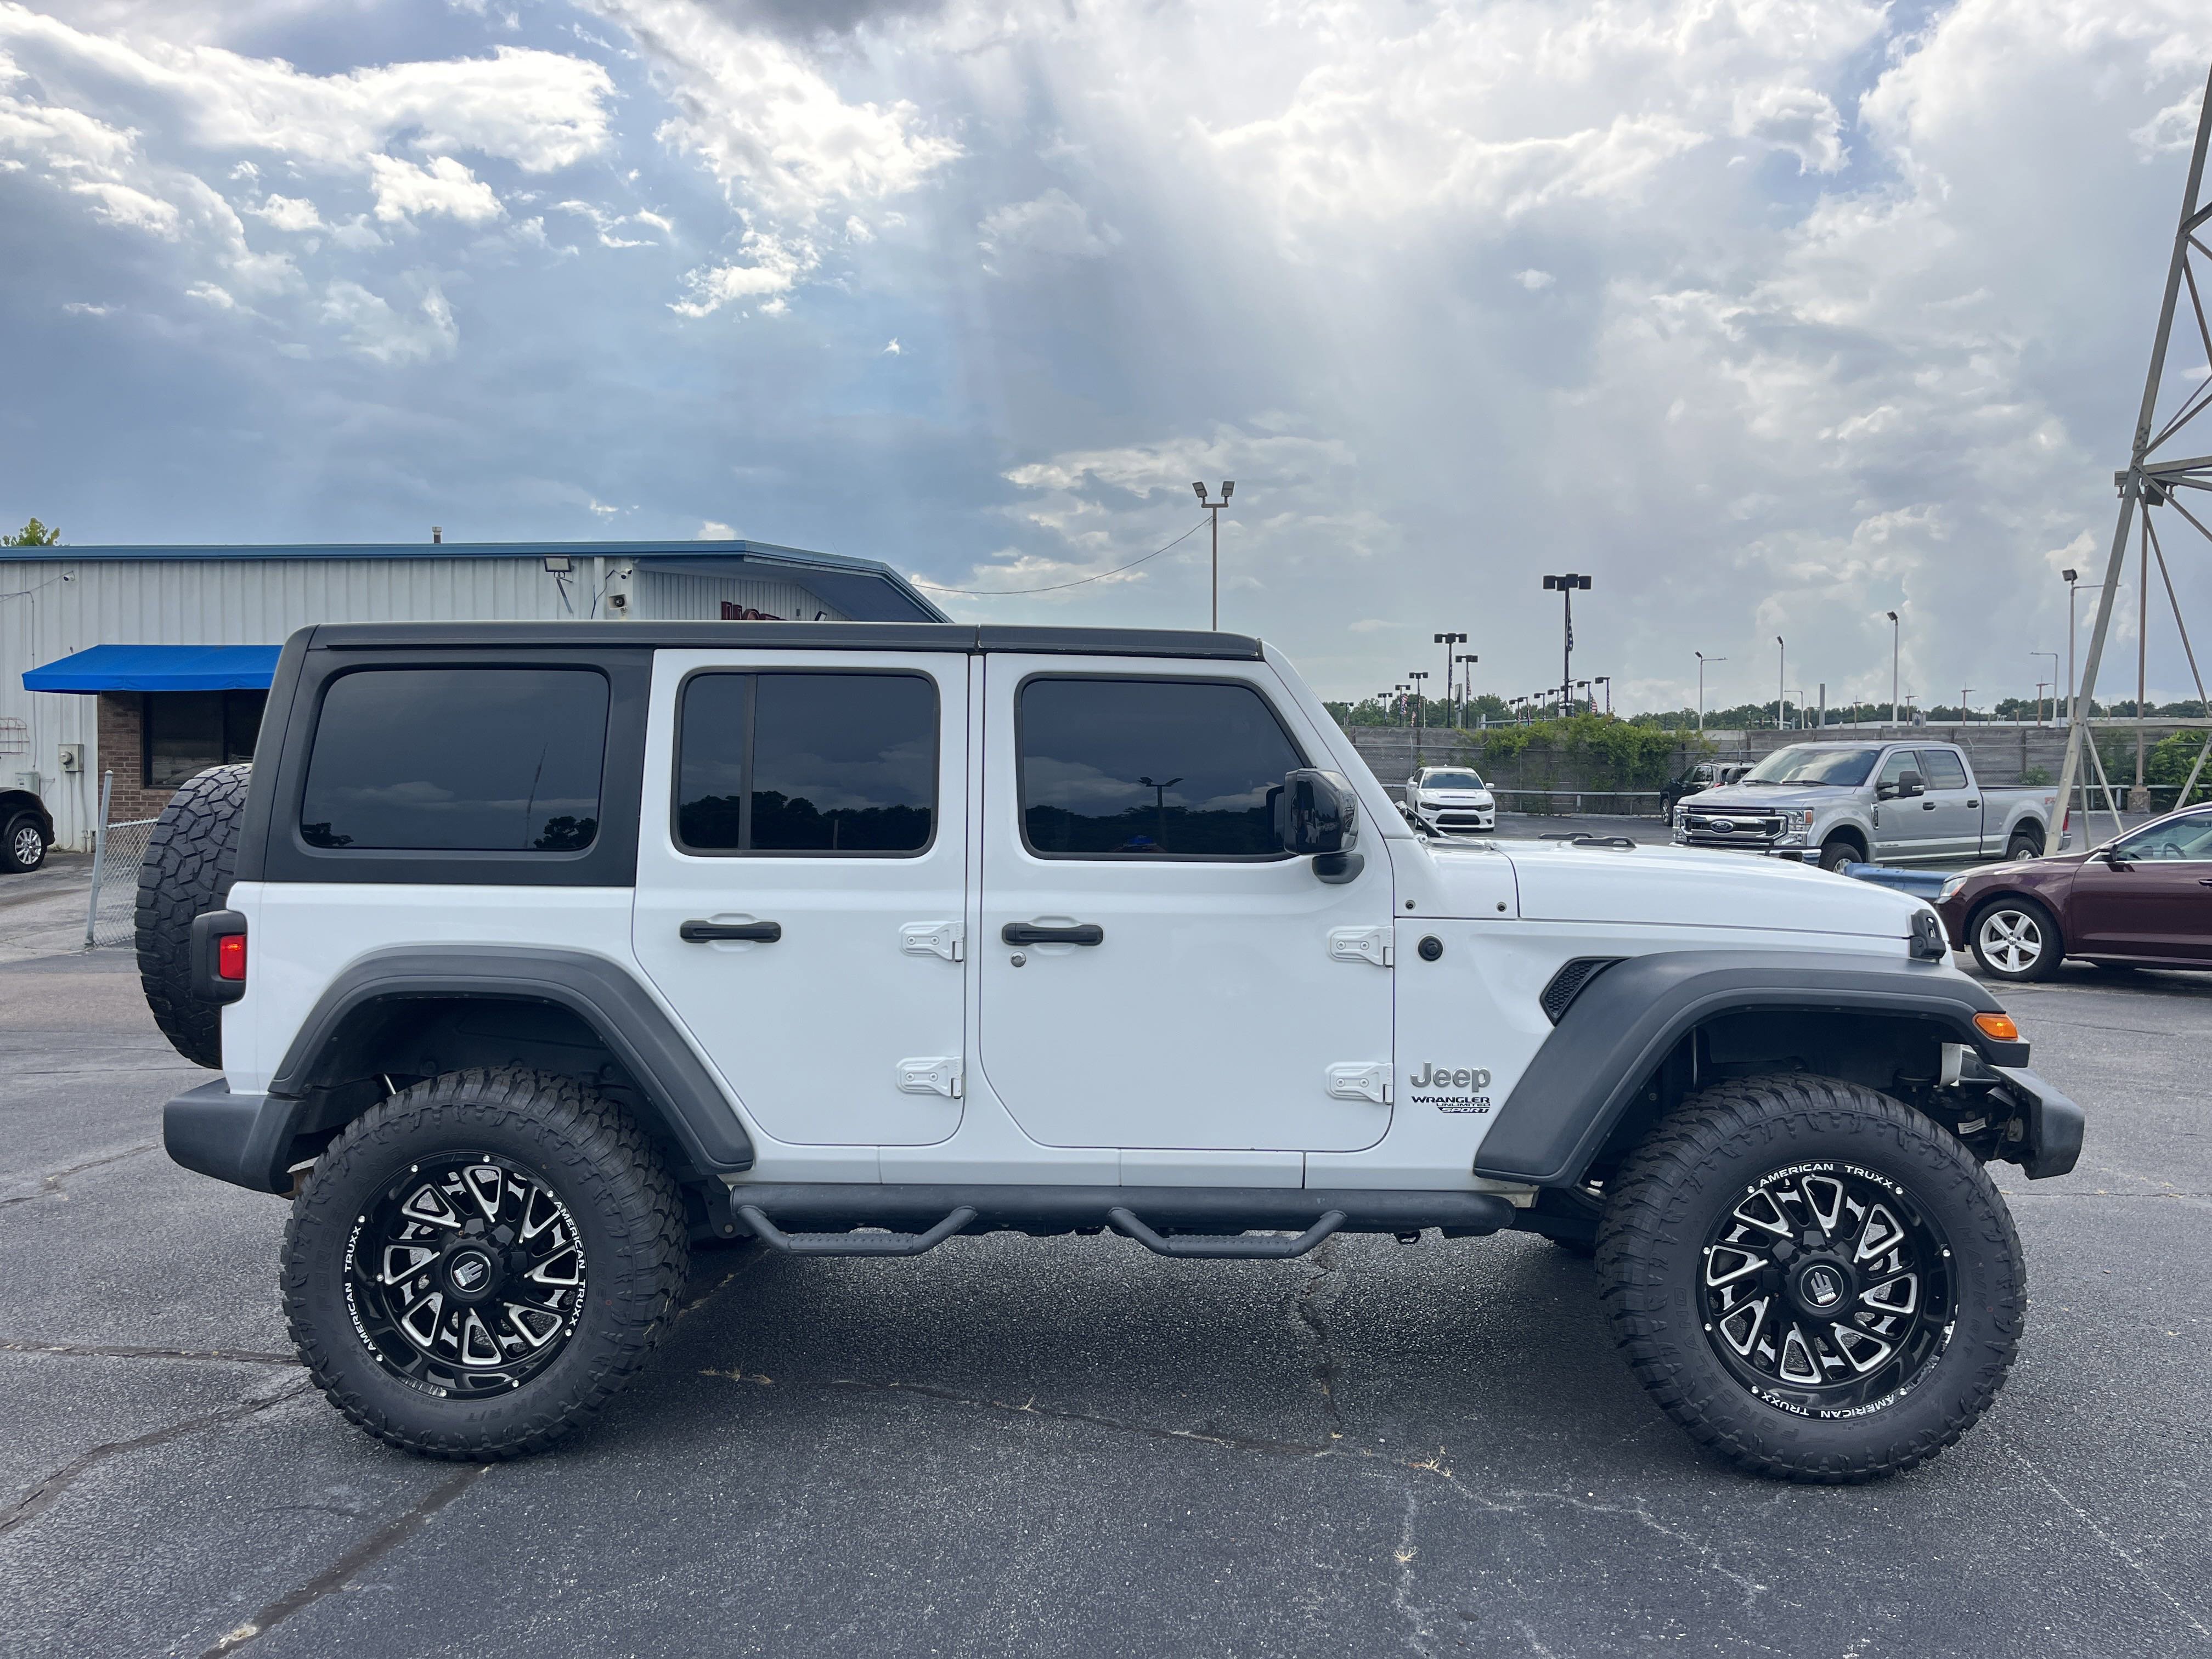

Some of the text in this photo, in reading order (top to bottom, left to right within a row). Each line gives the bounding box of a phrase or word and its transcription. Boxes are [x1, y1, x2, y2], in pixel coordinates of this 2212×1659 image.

[1410, 1061, 1491, 1093] Jeep
[1759, 1163, 1893, 1189] AMERICAN TRUXX
[554, 1201, 586, 1326] AMERICAN TRUXX
[345, 1225, 377, 1351] AMERICAN TRUXX
[1761, 1391, 1895, 1419] AMERICAN TRUXX
